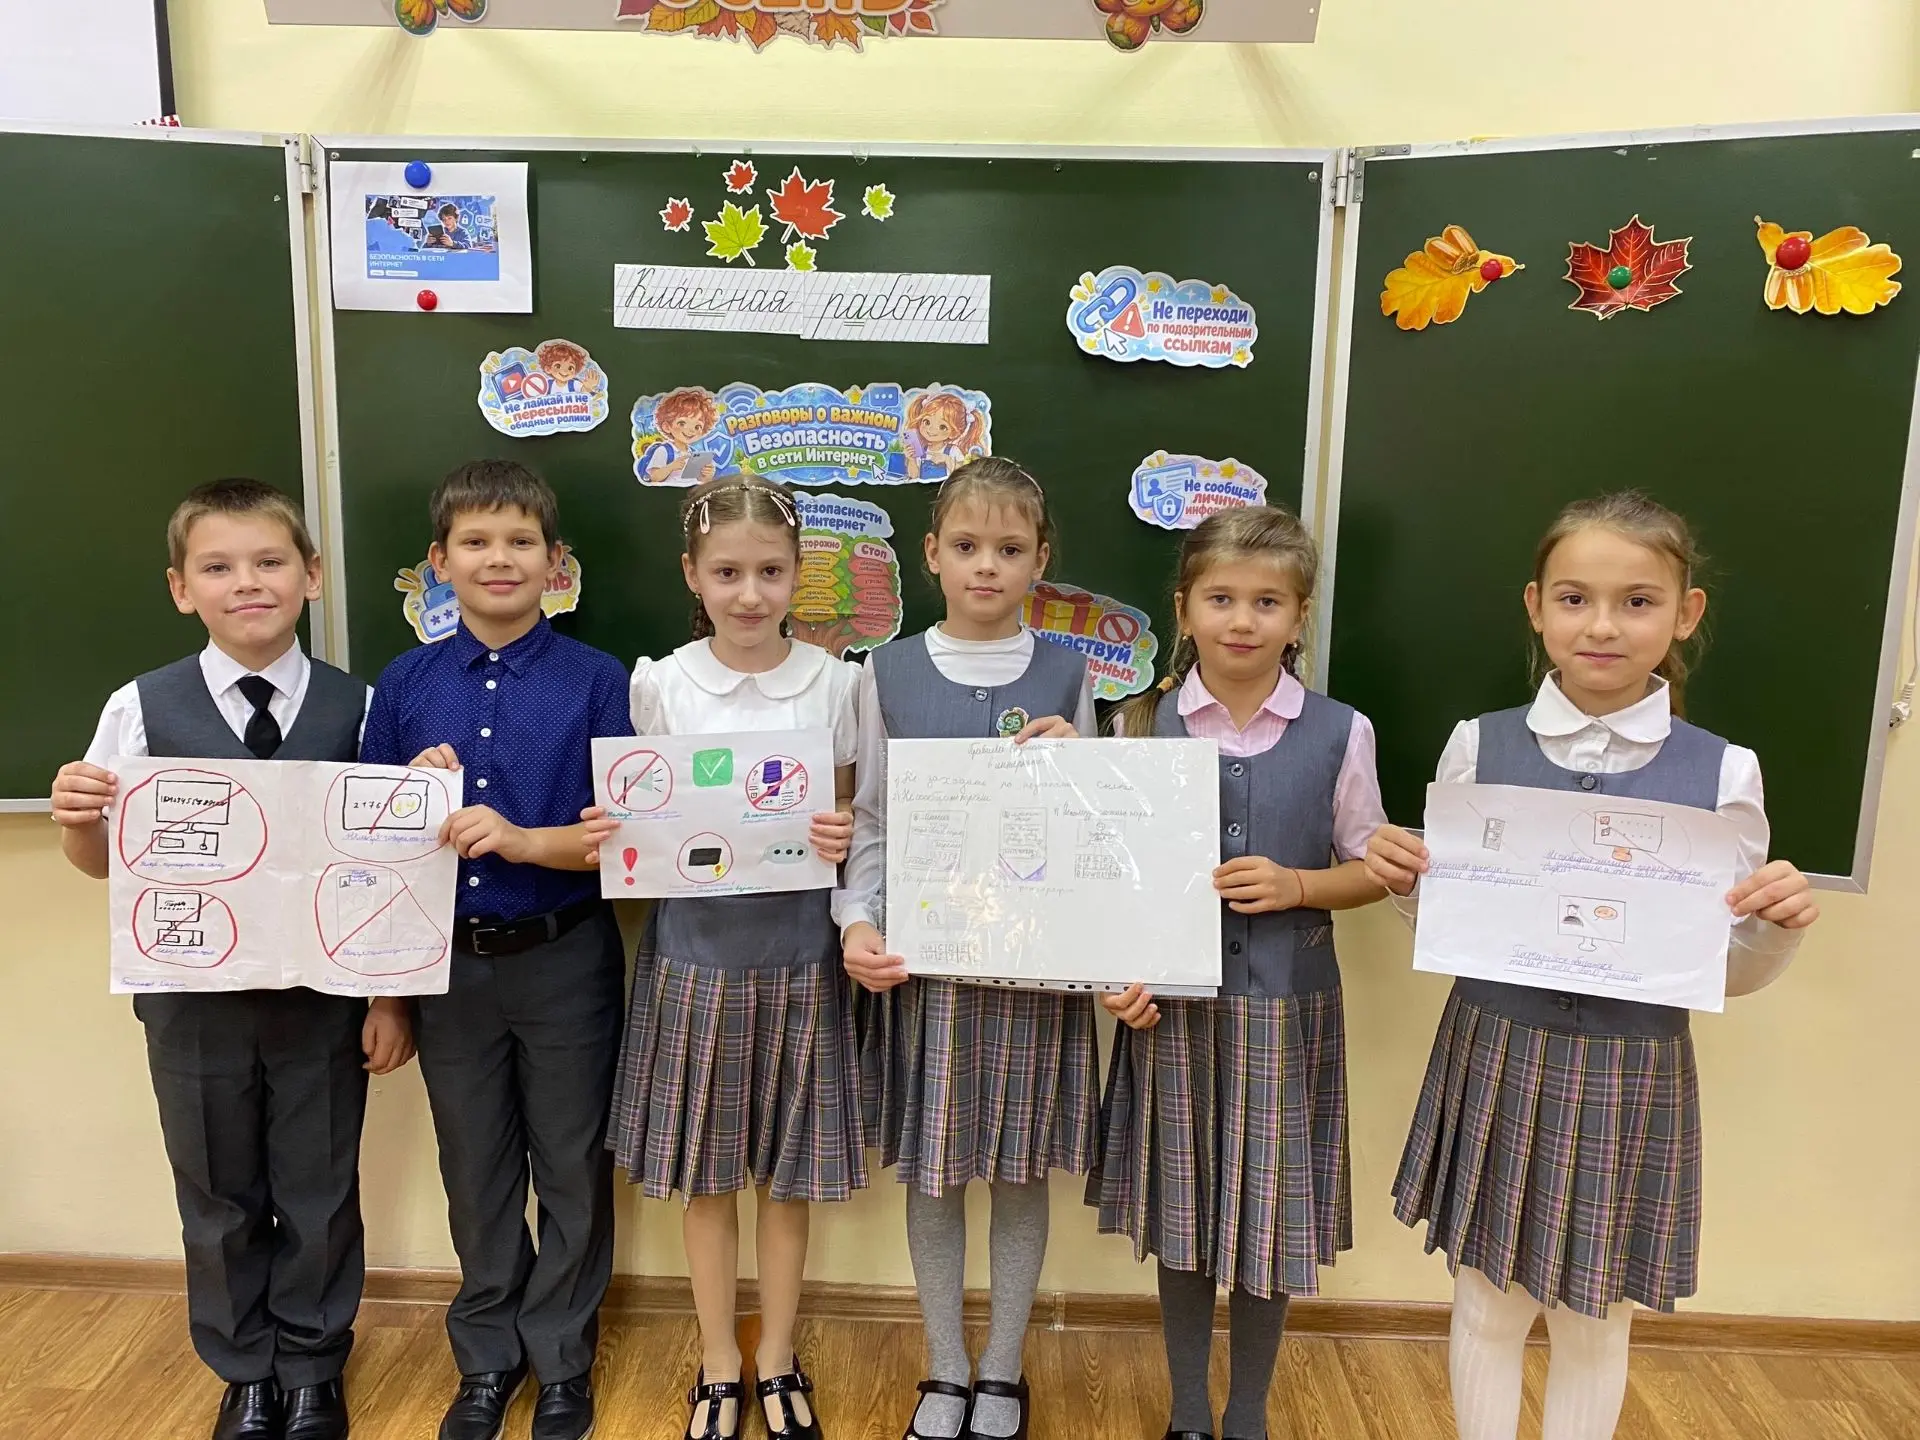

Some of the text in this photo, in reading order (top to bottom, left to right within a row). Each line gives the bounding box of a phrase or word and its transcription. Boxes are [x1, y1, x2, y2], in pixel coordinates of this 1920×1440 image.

[1152, 301, 1249, 324] Не переходи
[1147, 323, 1252, 340] по подозрительным
[1163, 338, 1232, 355] ссылкам
[504, 394, 589, 414] Не лайкай и не
[513, 402, 589, 422] пересылай
[510, 415, 591, 430] обидные ролики
[725, 407, 813, 433] Разговоры
[816, 407, 826, 422] о
[745, 429, 886, 454] Безопасность
[757, 448, 876, 469] в сети Интернет
[1184, 480, 1258, 500] Не сообщай
[1193, 493, 1246, 509] личную
[1185, 505, 1222, 518] инфор
[805, 514, 866, 532] Интернет
[799, 539, 841, 549] сторожно
[861, 545, 887, 559] Стоп
[1087, 657, 1137, 683] льных
